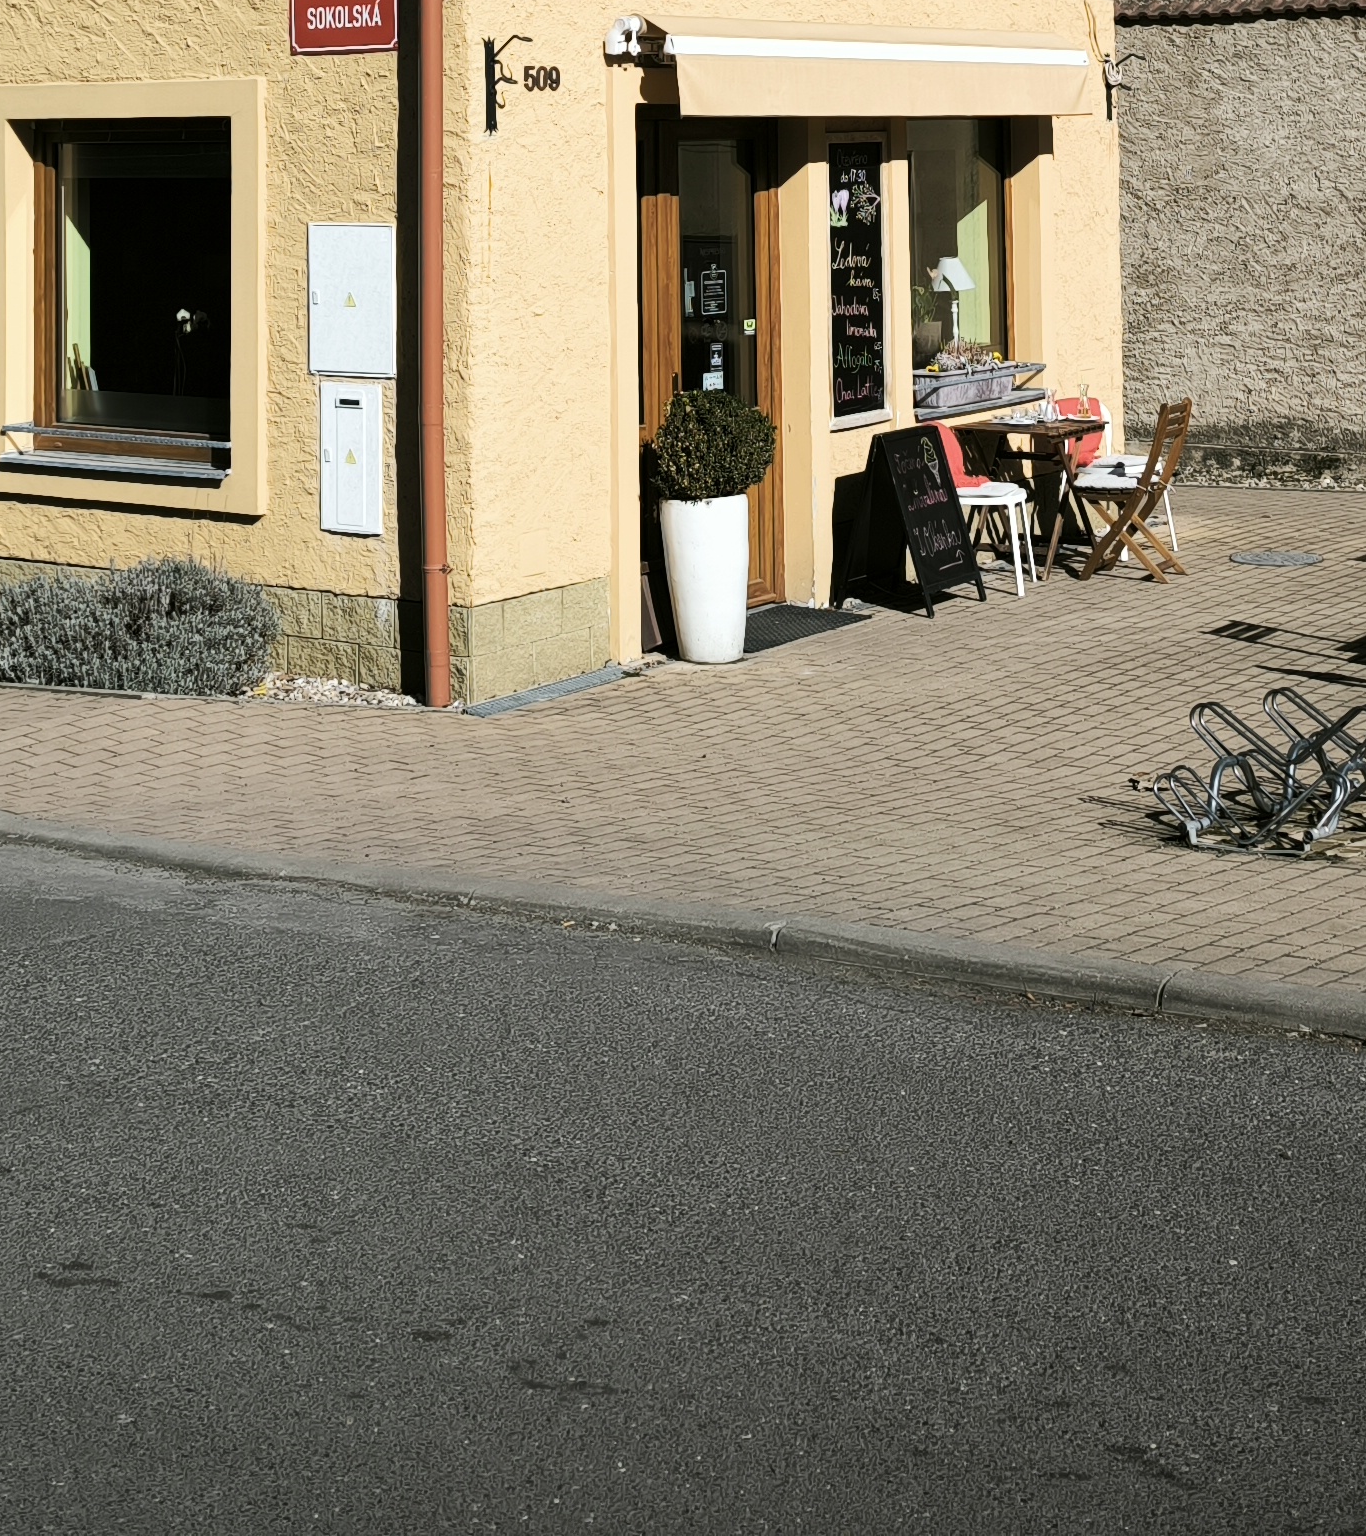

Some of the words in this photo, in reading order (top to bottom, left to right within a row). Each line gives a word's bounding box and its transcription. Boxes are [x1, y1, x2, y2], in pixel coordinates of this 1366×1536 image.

[523, 65, 561, 92] 509
[840, 170, 849, 183] do
[831, 237, 872, 270] Ledová
[846, 269, 874, 288] káva
[831, 295, 869, 317] Jahodová
